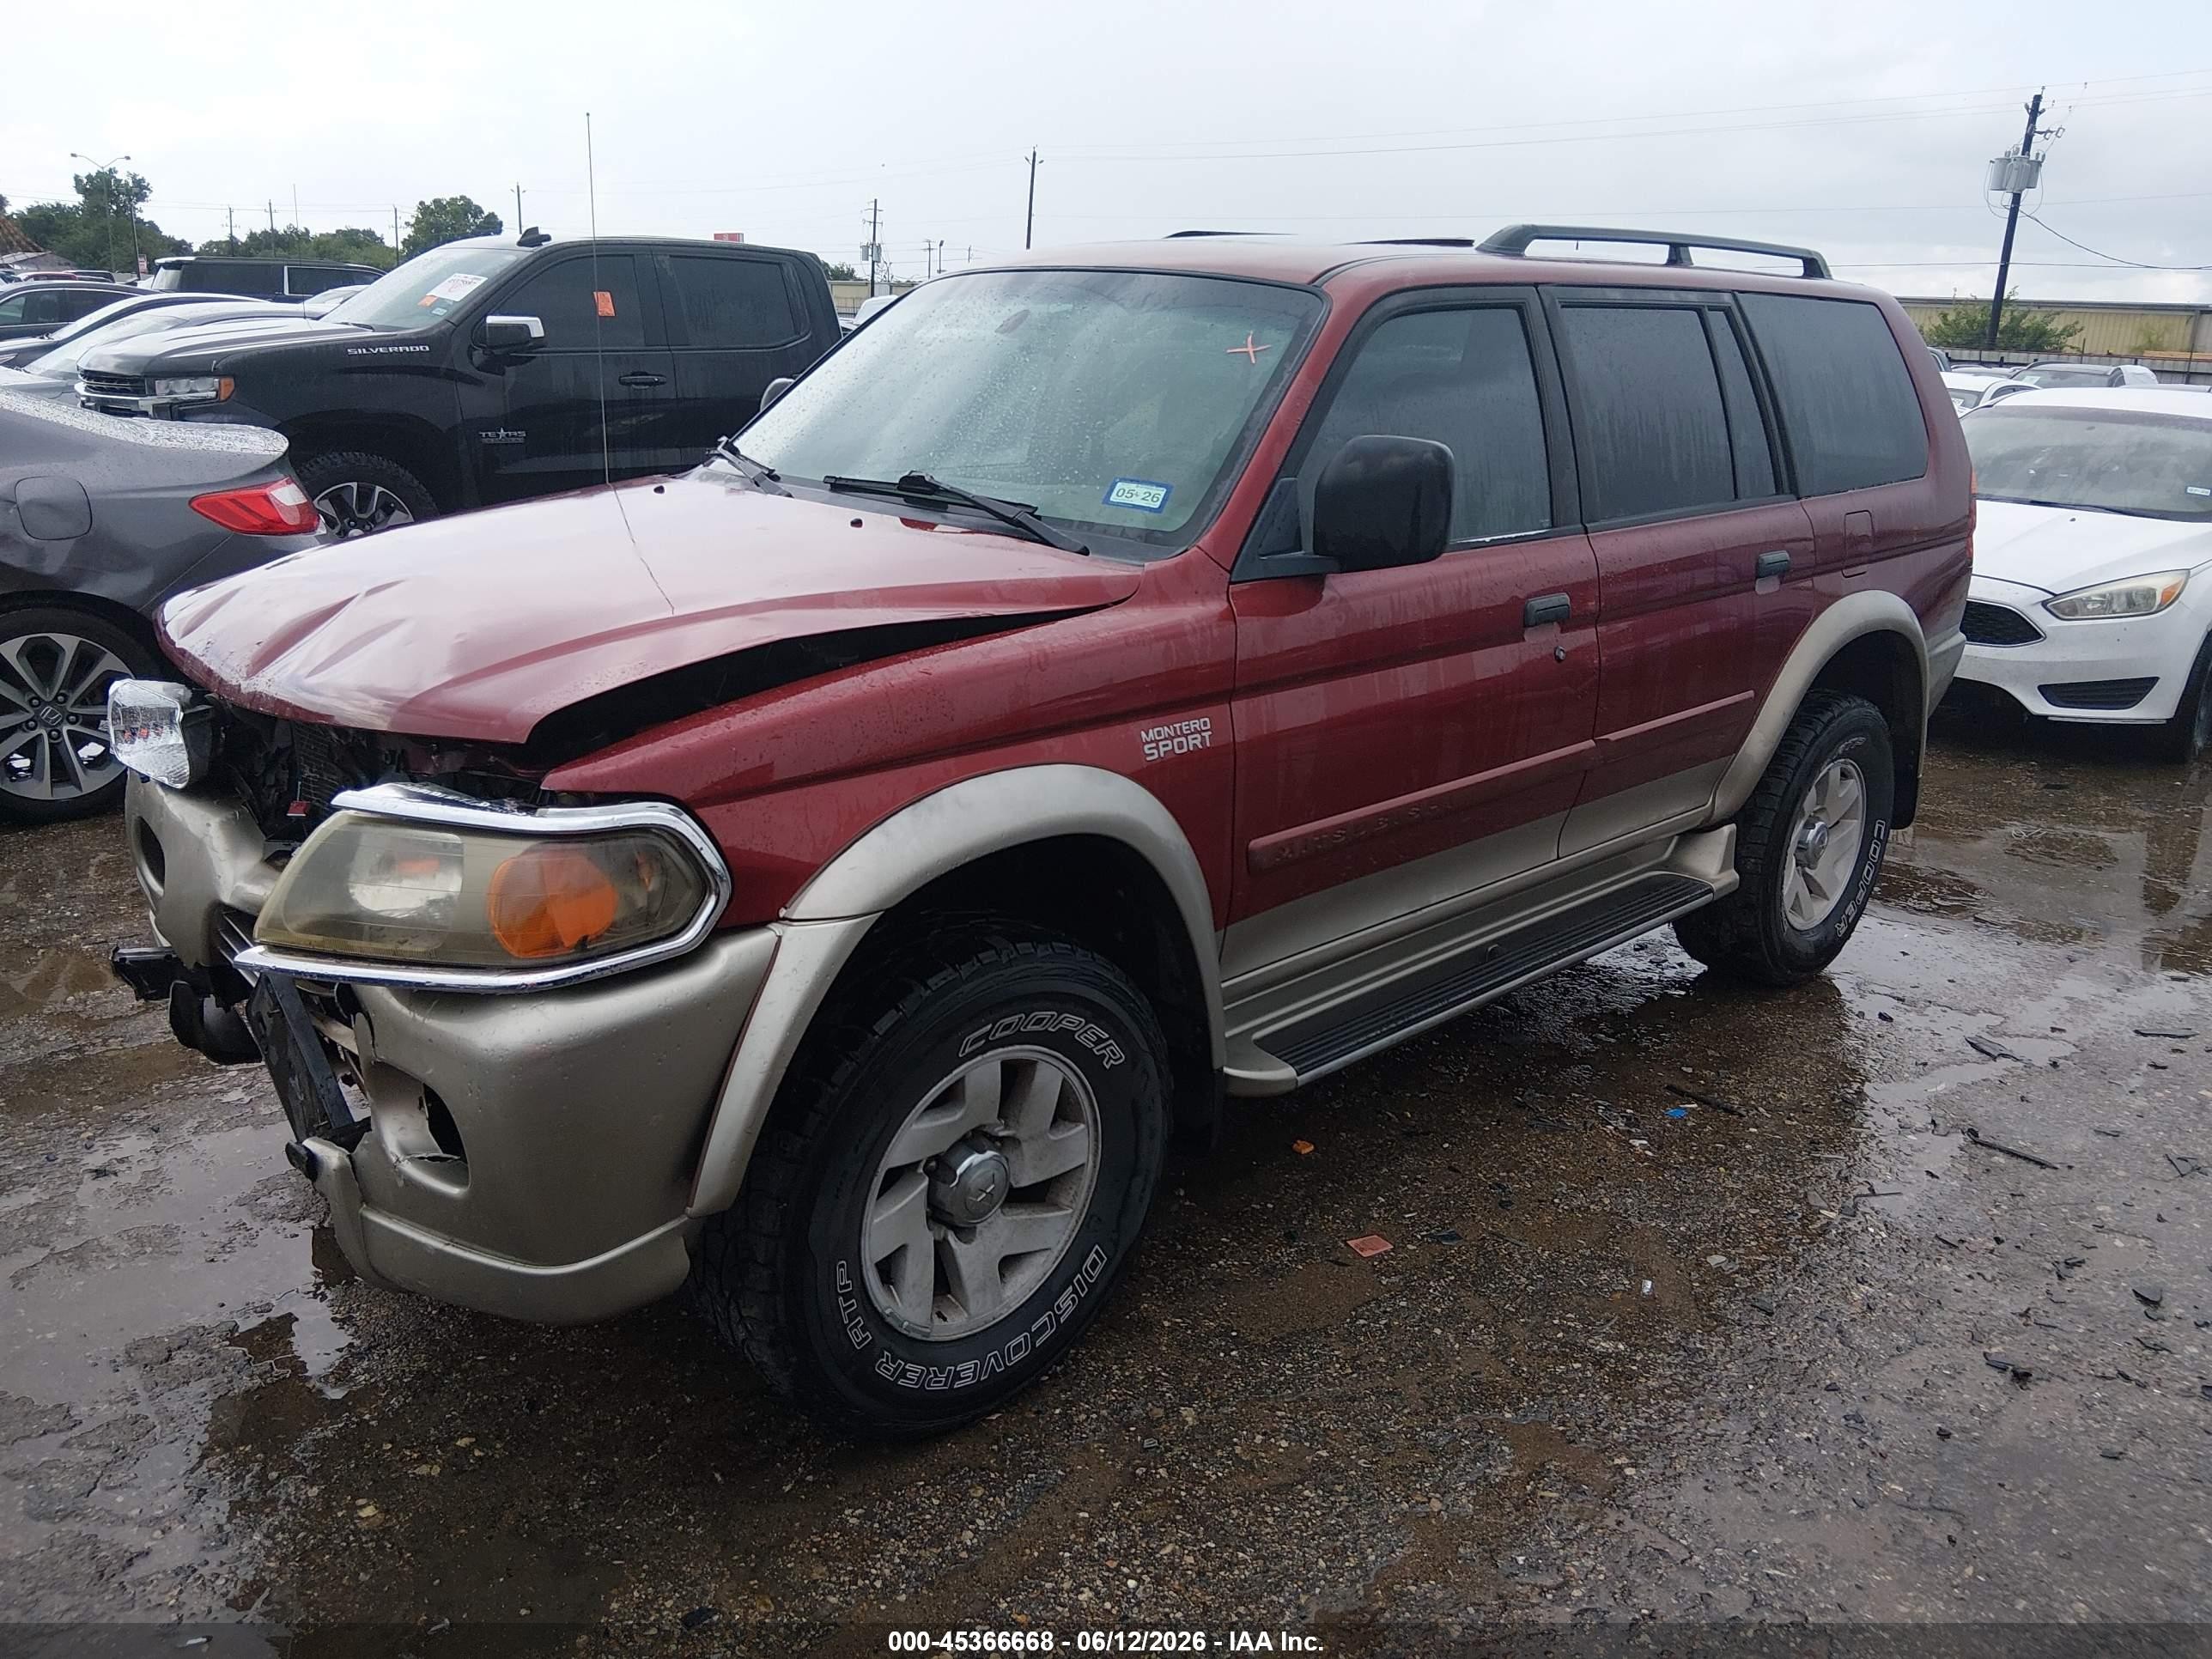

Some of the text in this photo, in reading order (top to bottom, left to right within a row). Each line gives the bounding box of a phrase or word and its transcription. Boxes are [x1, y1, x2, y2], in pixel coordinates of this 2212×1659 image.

[347, 345, 430, 356] SILVERADO
[1140, 490, 1162, 503] 26
[1140, 717, 1211, 743] MONTERO
[1143, 731, 1212, 762] SPORT
[1835, 819, 1886, 937] COOPER
[958, 1011, 1126, 1070] COOPER
[836, 1244, 1108, 1390] DISCOVERER ATP
